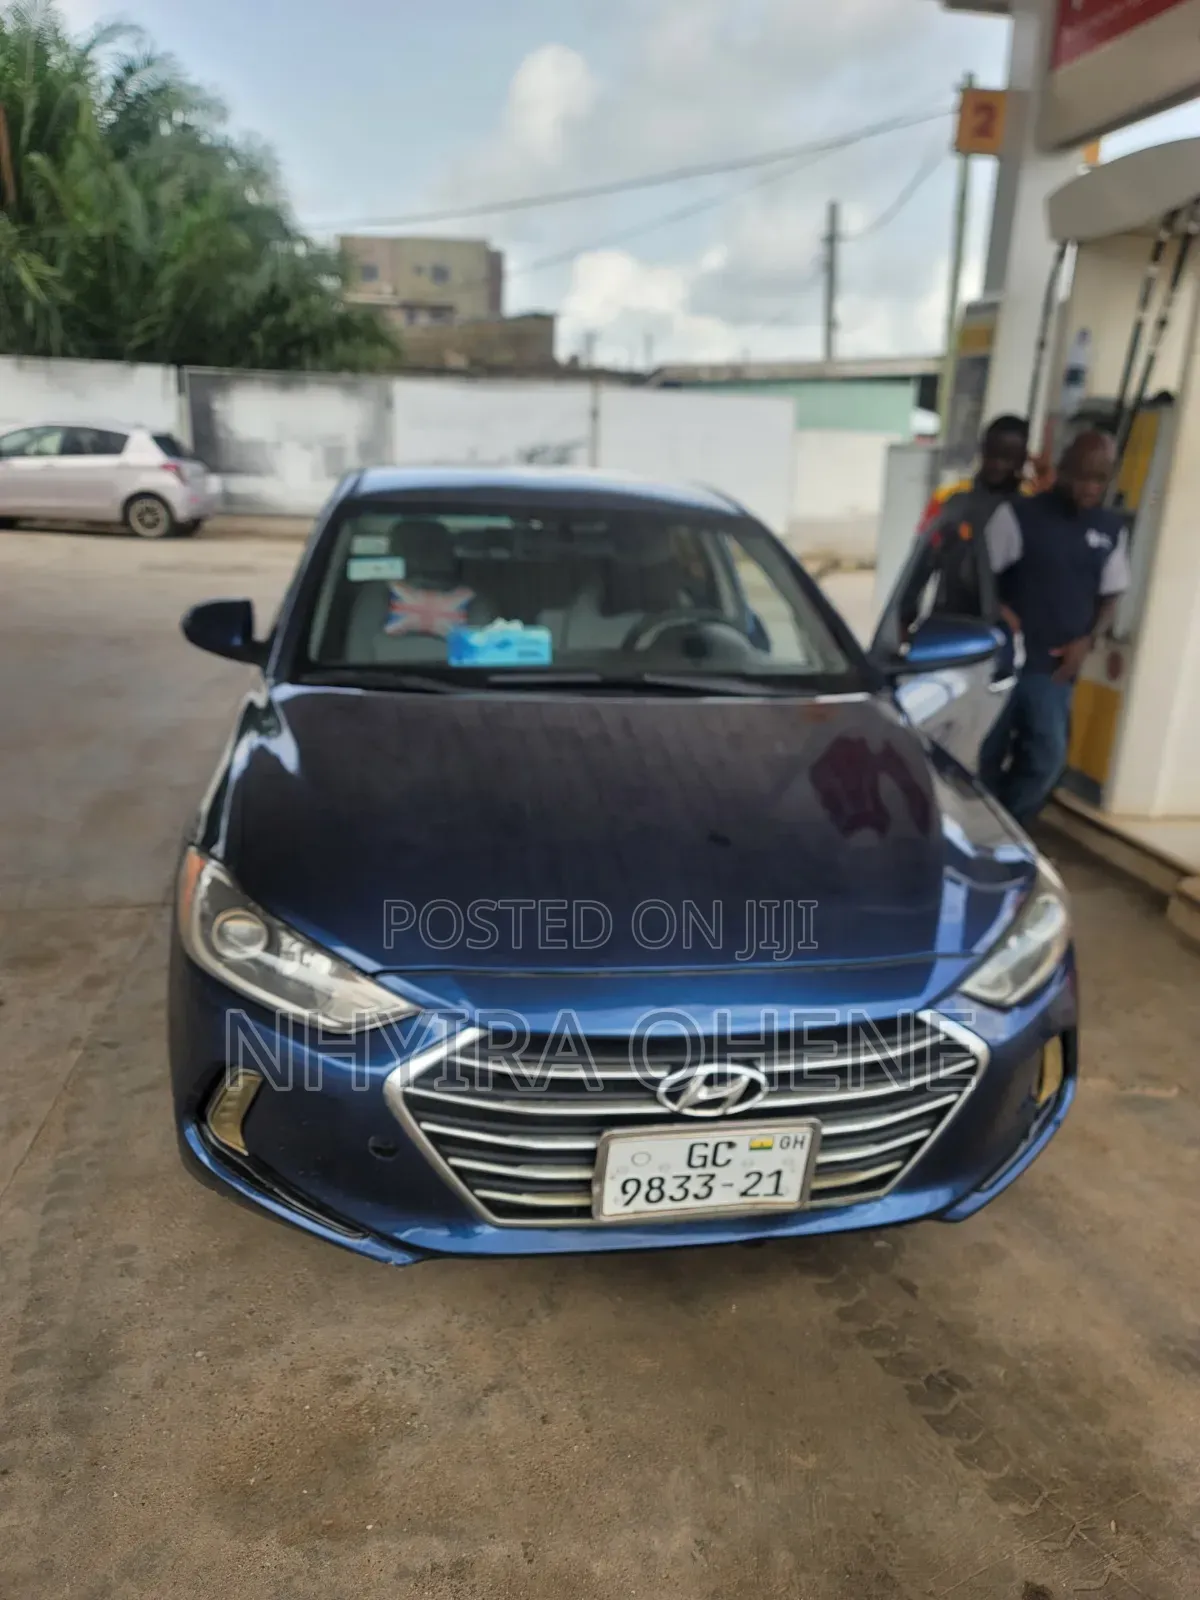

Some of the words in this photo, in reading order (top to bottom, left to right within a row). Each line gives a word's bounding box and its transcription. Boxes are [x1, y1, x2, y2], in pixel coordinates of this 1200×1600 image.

[973, 104, 996, 139] 2
[687, 1141, 736, 1169] GC
[779, 1136, 805, 1150] GH
[621, 1169, 784, 1207] 9833-21
